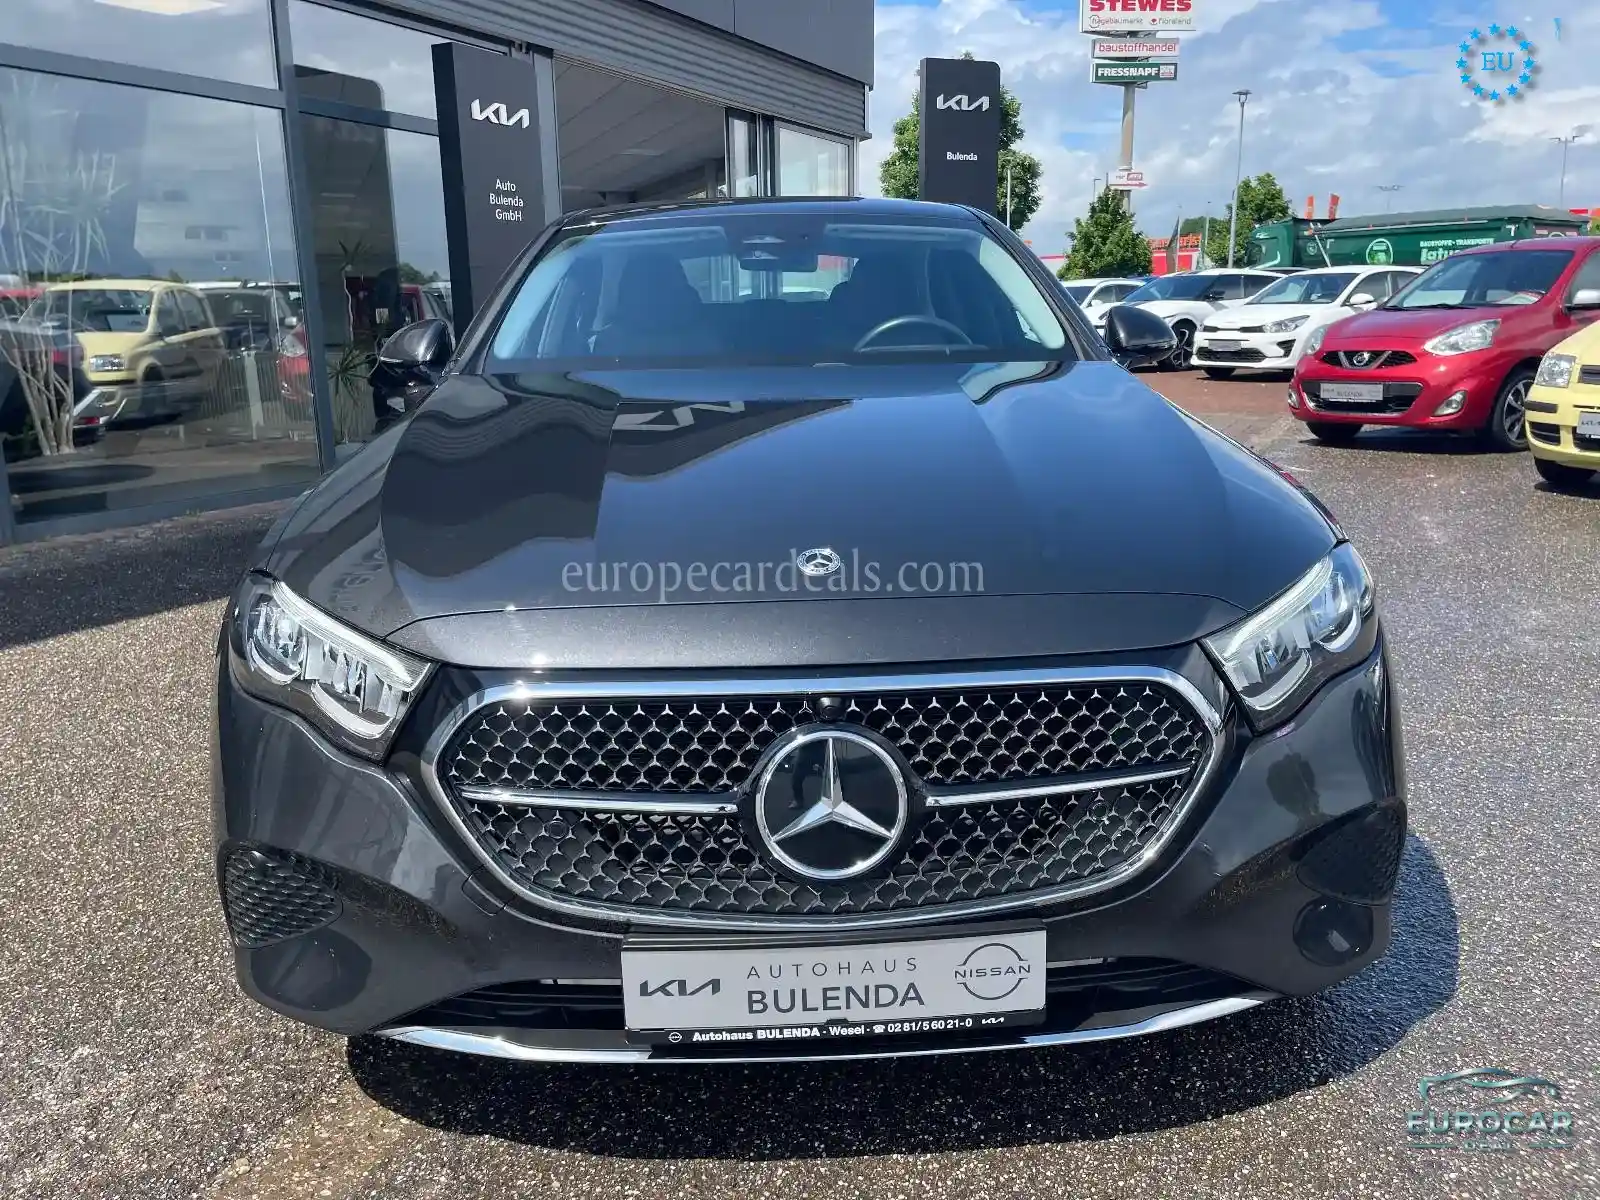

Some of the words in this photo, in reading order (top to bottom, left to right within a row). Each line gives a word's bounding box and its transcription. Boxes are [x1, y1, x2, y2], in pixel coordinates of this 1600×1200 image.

[1089, 0, 1192, 12] STEWES
[1098, 43, 1176, 52] baustoffhandel
[1097, 67, 1159, 77] FRESSNAPF
[936, 94, 990, 111] KIA
[470, 99, 530, 128] KIA
[946, 151, 978, 161] Bulenda
[495, 179, 516, 192] Auto
[489, 193, 524, 207] Bulenda
[495, 209, 522, 222] GmbH
[747, 957, 917, 979] AUTOHAUS
[639, 978, 721, 997] KIA
[747, 982, 925, 1015] BULENDA
[954, 964, 1031, 980] NISSAN
[692, 1031, 754, 1042] Autohaus
[757, 1028, 820, 1039] BULENDA
[829, 1025, 865, 1036] Wesel
